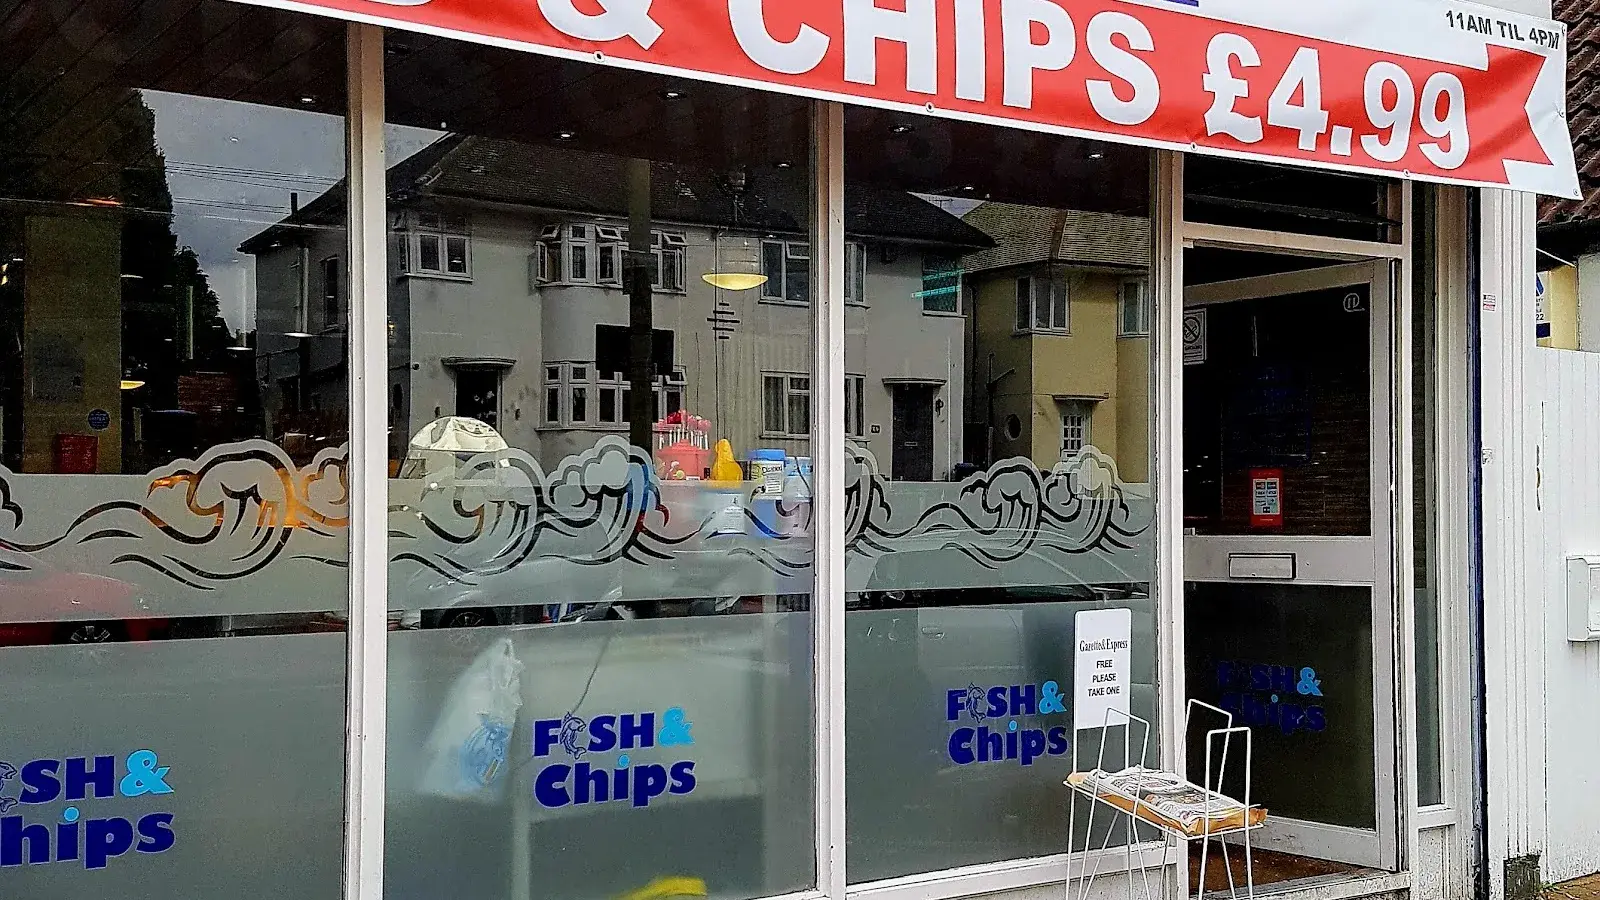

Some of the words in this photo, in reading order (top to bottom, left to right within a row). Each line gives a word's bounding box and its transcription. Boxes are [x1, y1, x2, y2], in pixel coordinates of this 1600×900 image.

[1446, 10, 1492, 35] 11AM
[1497, 20, 1525, 41] TIL
[1529, 28, 1560, 49] 4PM
[726, 0, 1161, 126] CHIPS
[1202, 32, 1470, 170] £4.99
[1092, 673, 1116, 683] PLEASE
[1096, 659, 1113, 669] FREE
[1088, 687, 1105, 697] TAKE
[1106, 685, 1120, 695] ONE
[947, 720, 1068, 766] Chips
[534, 753, 697, 808] Chips
[0, 806, 176, 871] hips
